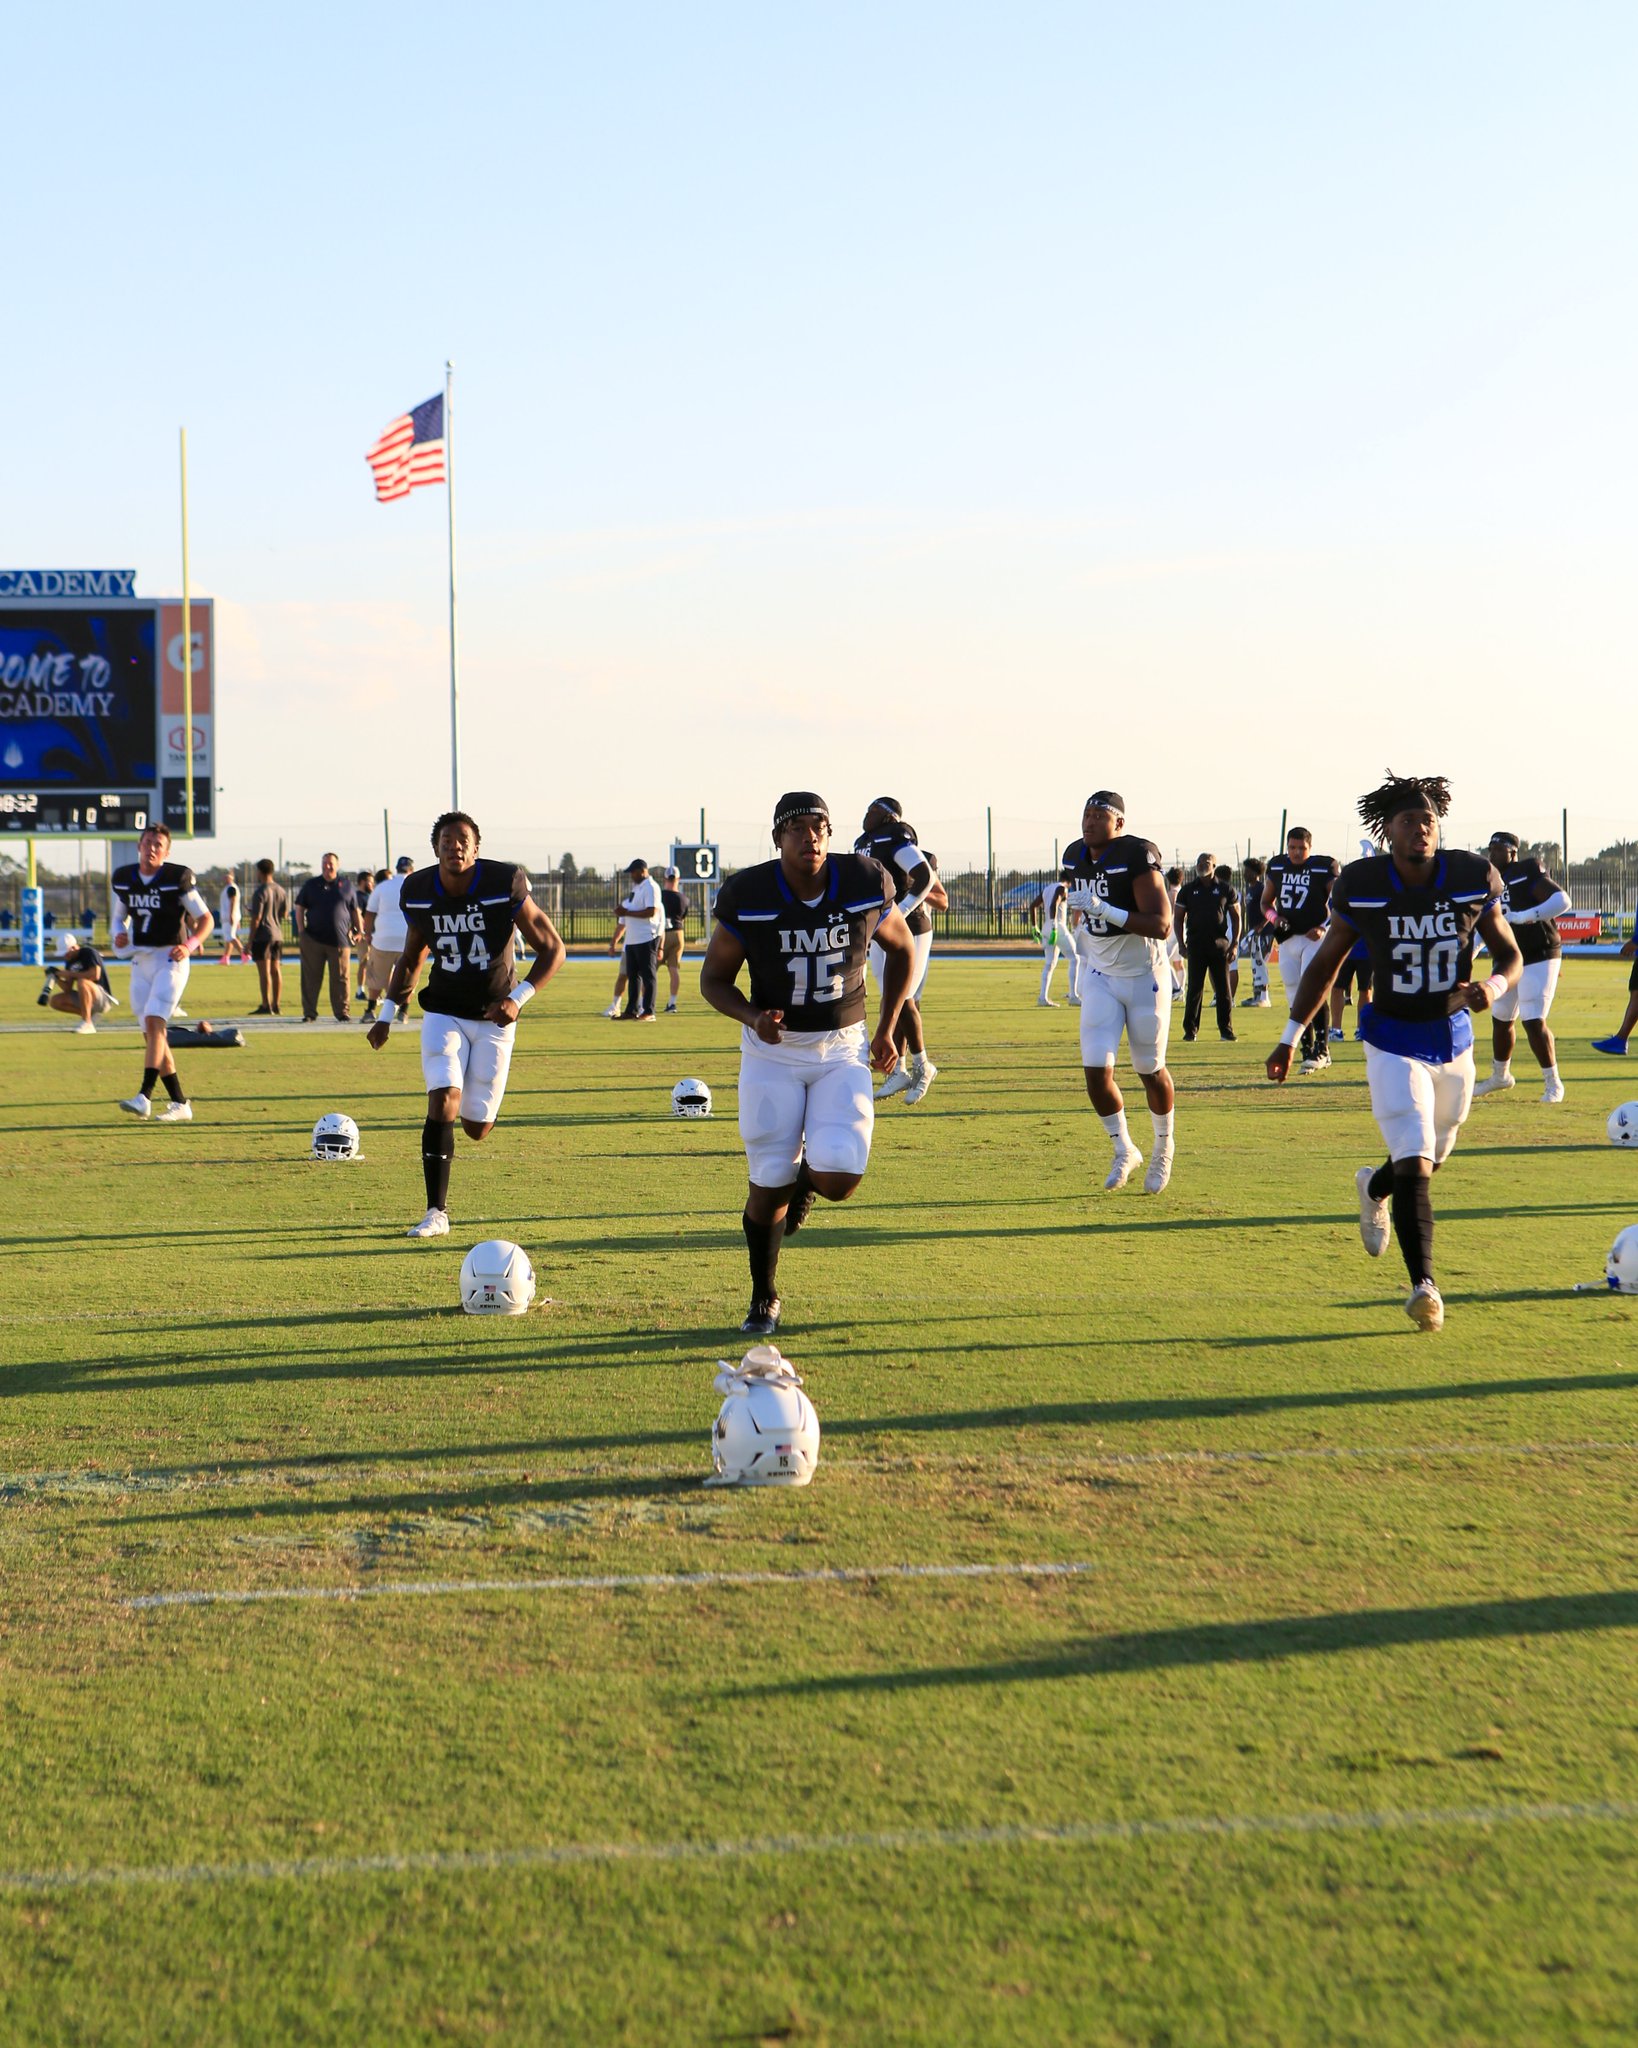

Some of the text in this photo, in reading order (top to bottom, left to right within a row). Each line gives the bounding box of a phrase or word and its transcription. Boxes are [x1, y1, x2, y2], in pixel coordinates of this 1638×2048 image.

[167, 633, 204, 673] G
[0, 653, 111, 692] OME TO
[86, 807, 97, 823] 0
[134, 811, 147, 830] 0
[695, 848, 714, 878] 0
[1281, 873, 1311, 886] IMG
[128, 894, 160, 909] IMG
[1280, 884, 1309, 909] 57
[137, 908, 152, 933] 7
[431, 912, 486, 934] IMG
[1387, 912, 1458, 940] IMG
[1556, 921, 1591, 930] TORADE
[779, 923, 850, 952] IMG
[437, 934, 490, 972] 34
[787, 952, 844, 1005] 15
[1392, 940, 1458, 994] 30
[485, 1293, 495, 1301] 34
[780, 1456, 788, 1467] 15
